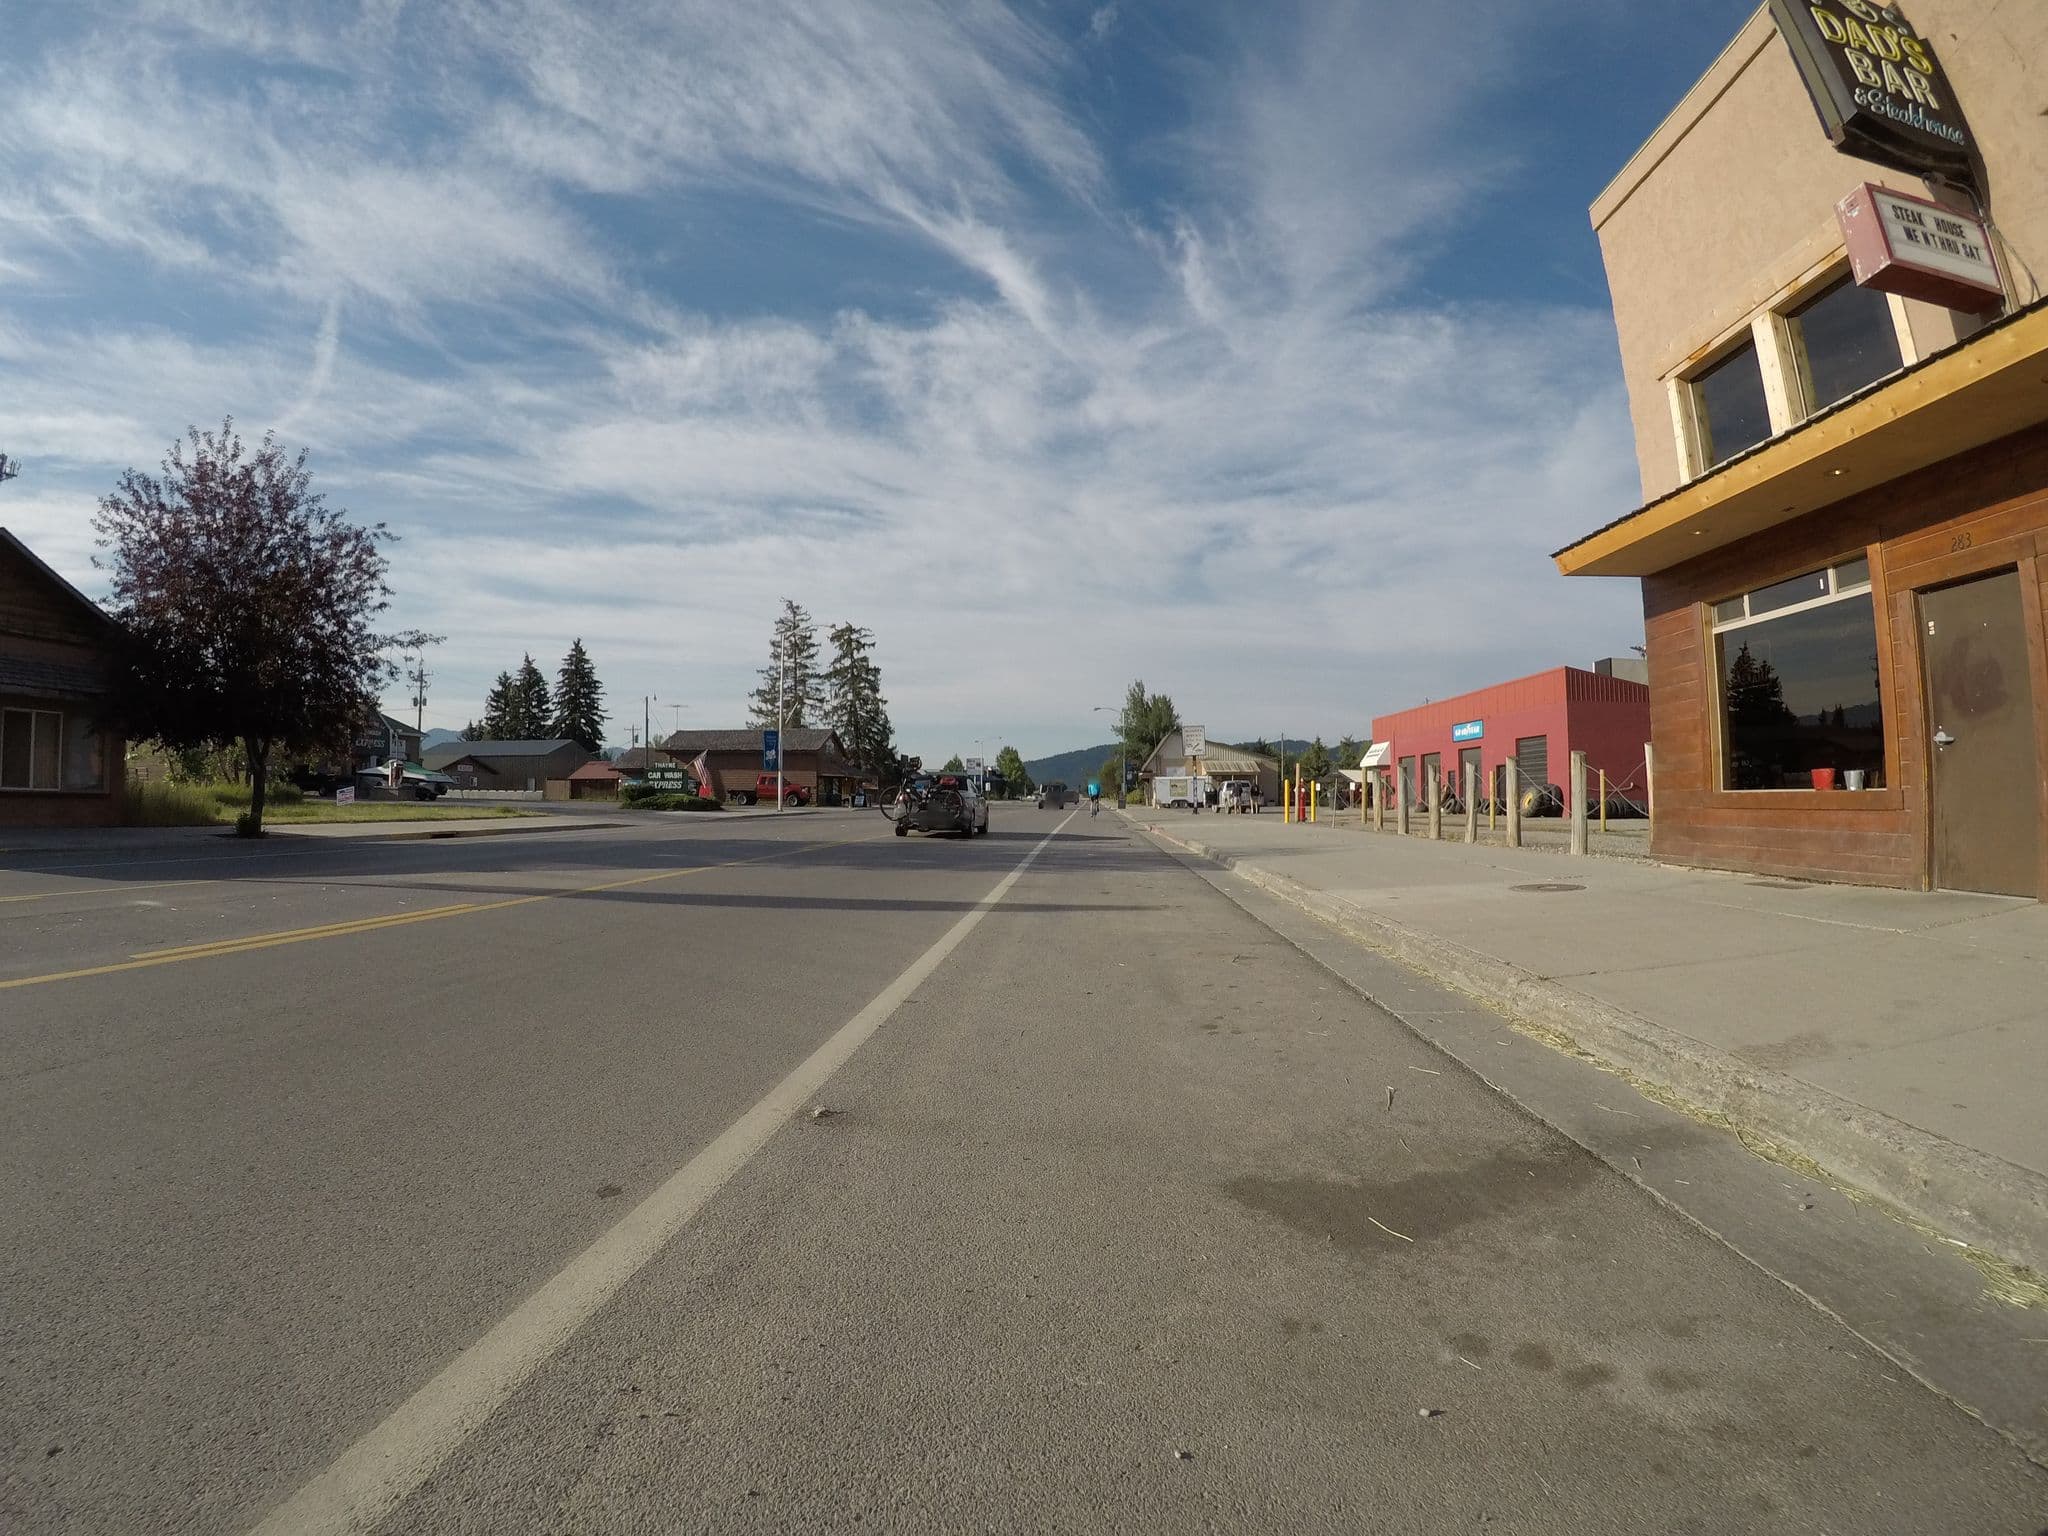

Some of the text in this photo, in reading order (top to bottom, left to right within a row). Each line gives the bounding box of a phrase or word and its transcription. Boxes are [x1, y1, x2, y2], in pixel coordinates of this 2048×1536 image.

[1810, 6, 1933, 75] DAD'S
[1844, 47, 1940, 110] BAR
[1867, 88, 1964, 146] Steakhouse
[1892, 204, 1966, 239] STEAK HOUSE
[1961, 243, 1981, 261] SAT
[1951, 532, 1971, 553] 283
[647, 771, 683, 779] CAR WASH
